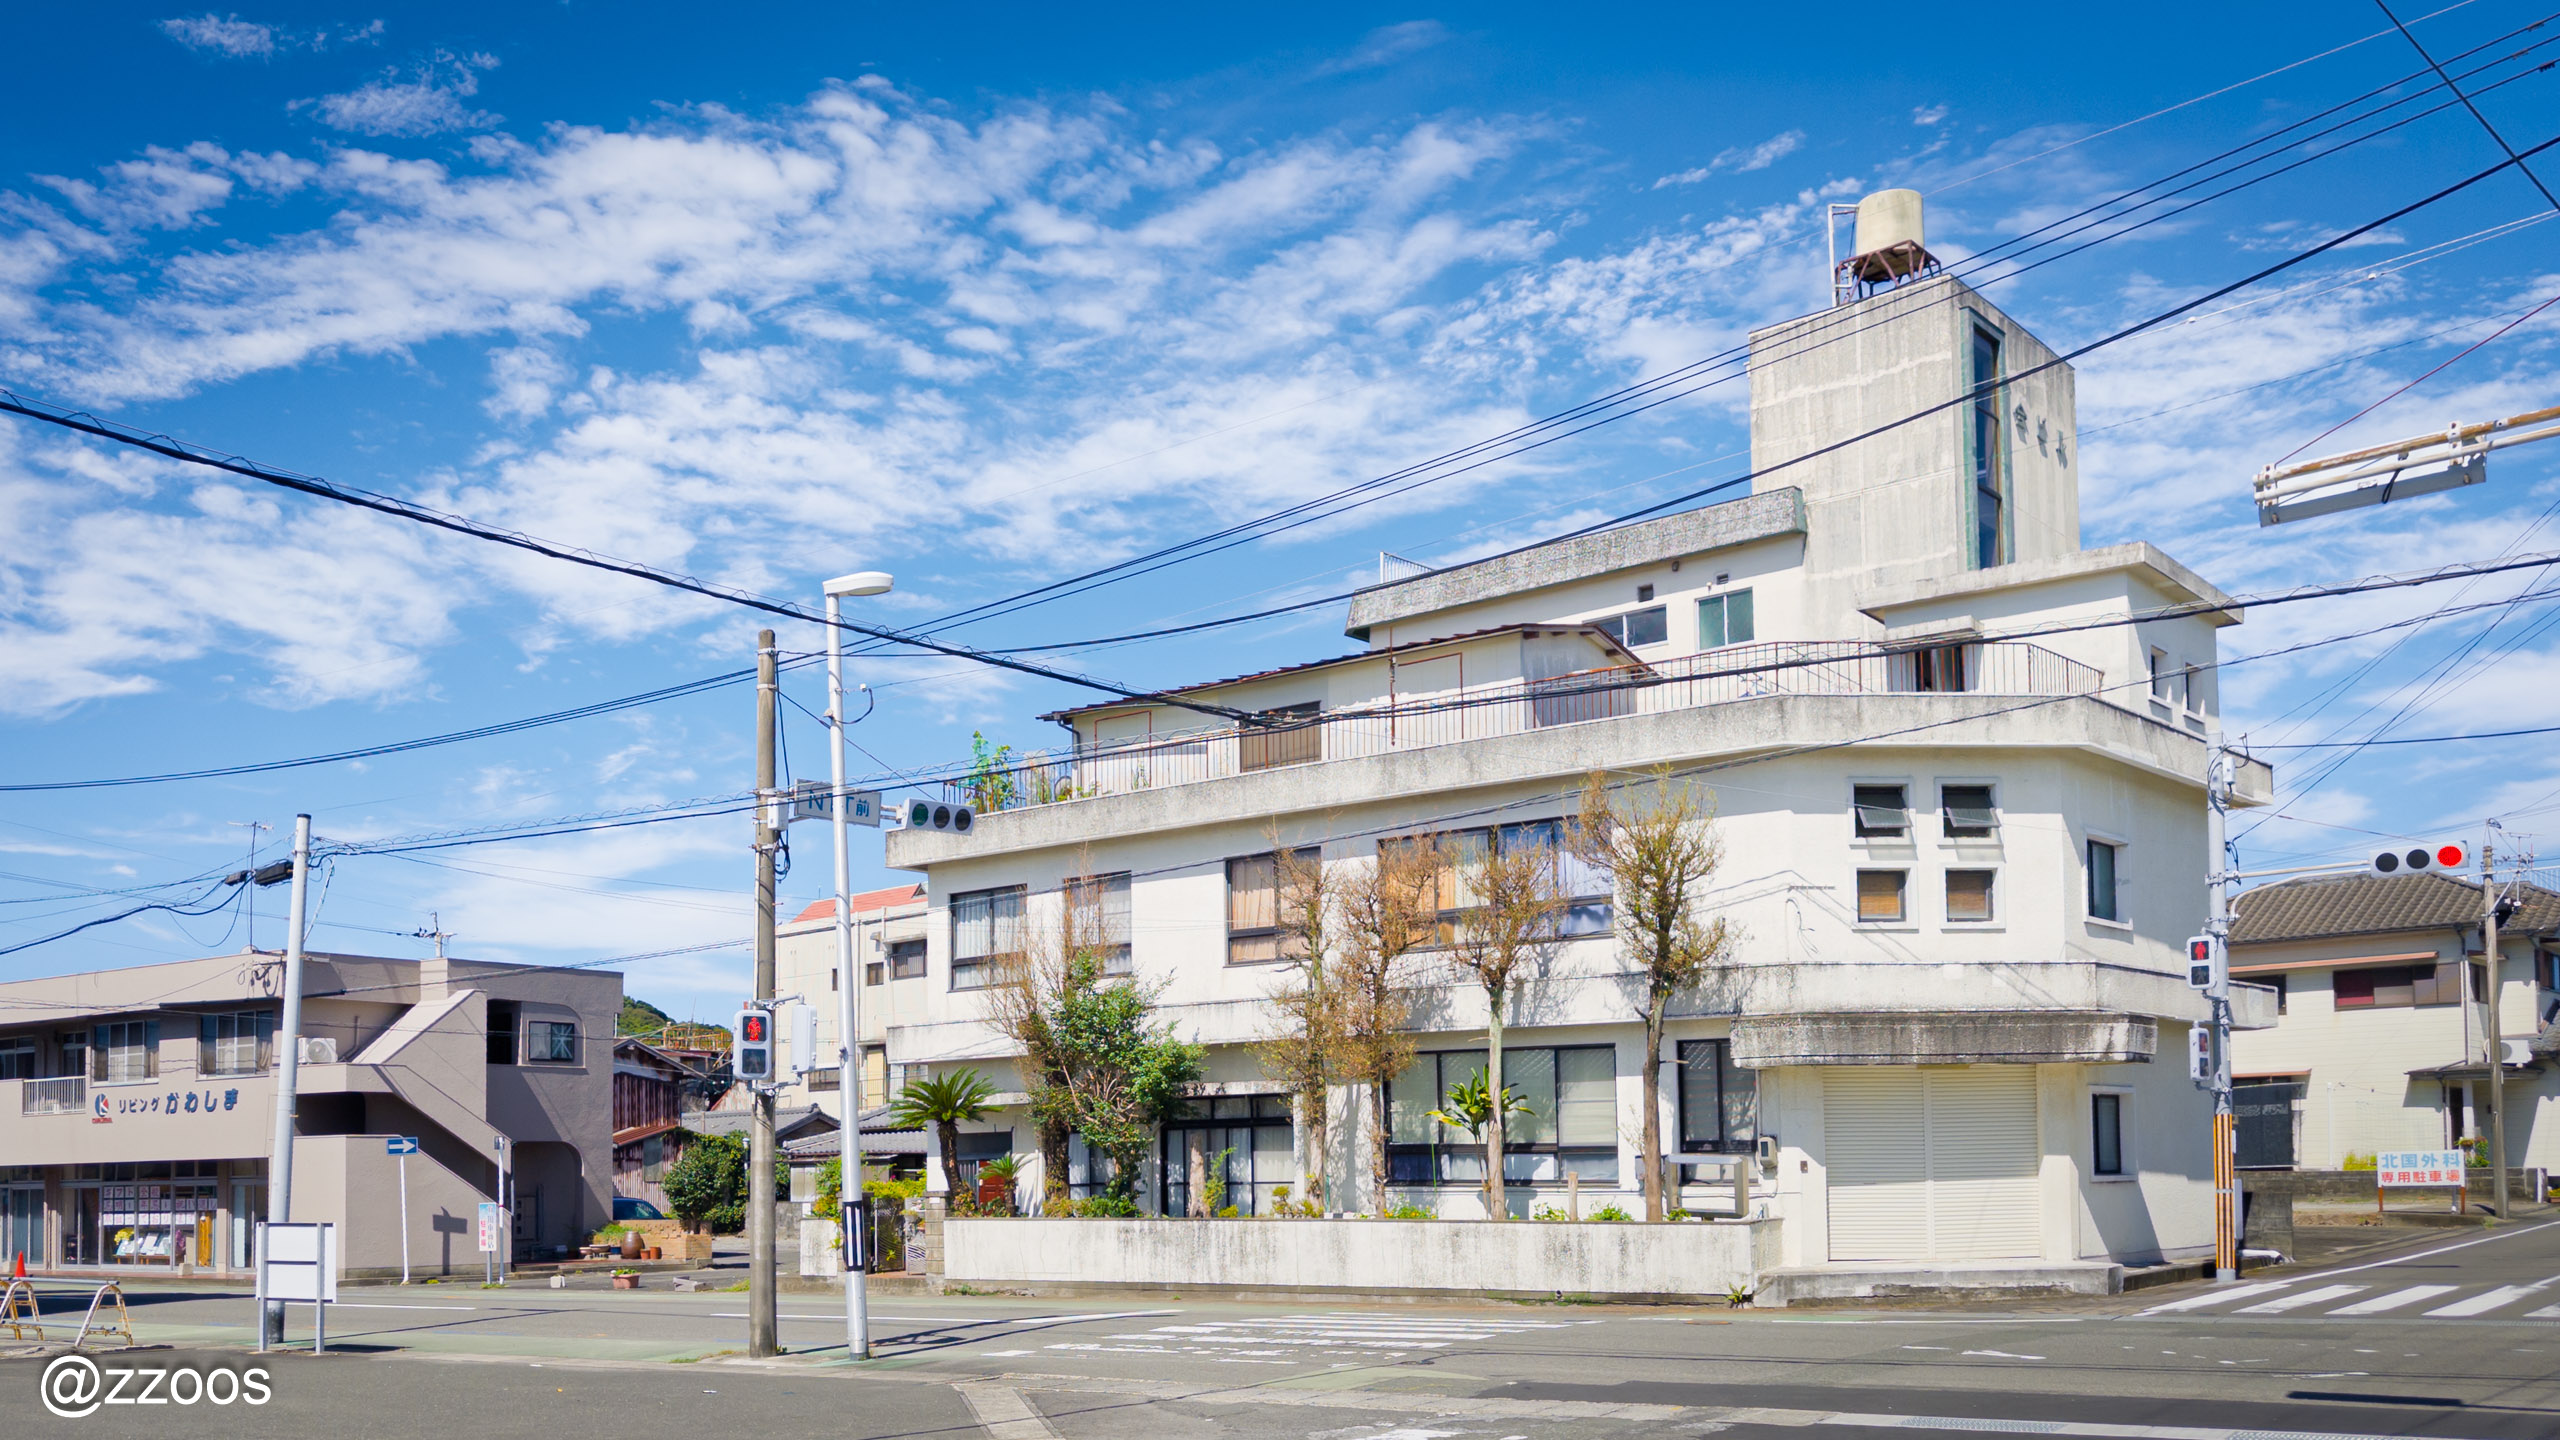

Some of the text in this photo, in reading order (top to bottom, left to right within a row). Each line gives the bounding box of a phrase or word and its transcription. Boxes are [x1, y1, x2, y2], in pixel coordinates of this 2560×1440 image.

[119, 1088, 239, 1114] リビング かわしま
[2381, 1152, 2460, 1168] 北国外科
[2381, 1170, 2460, 1183] 専用駐車場
